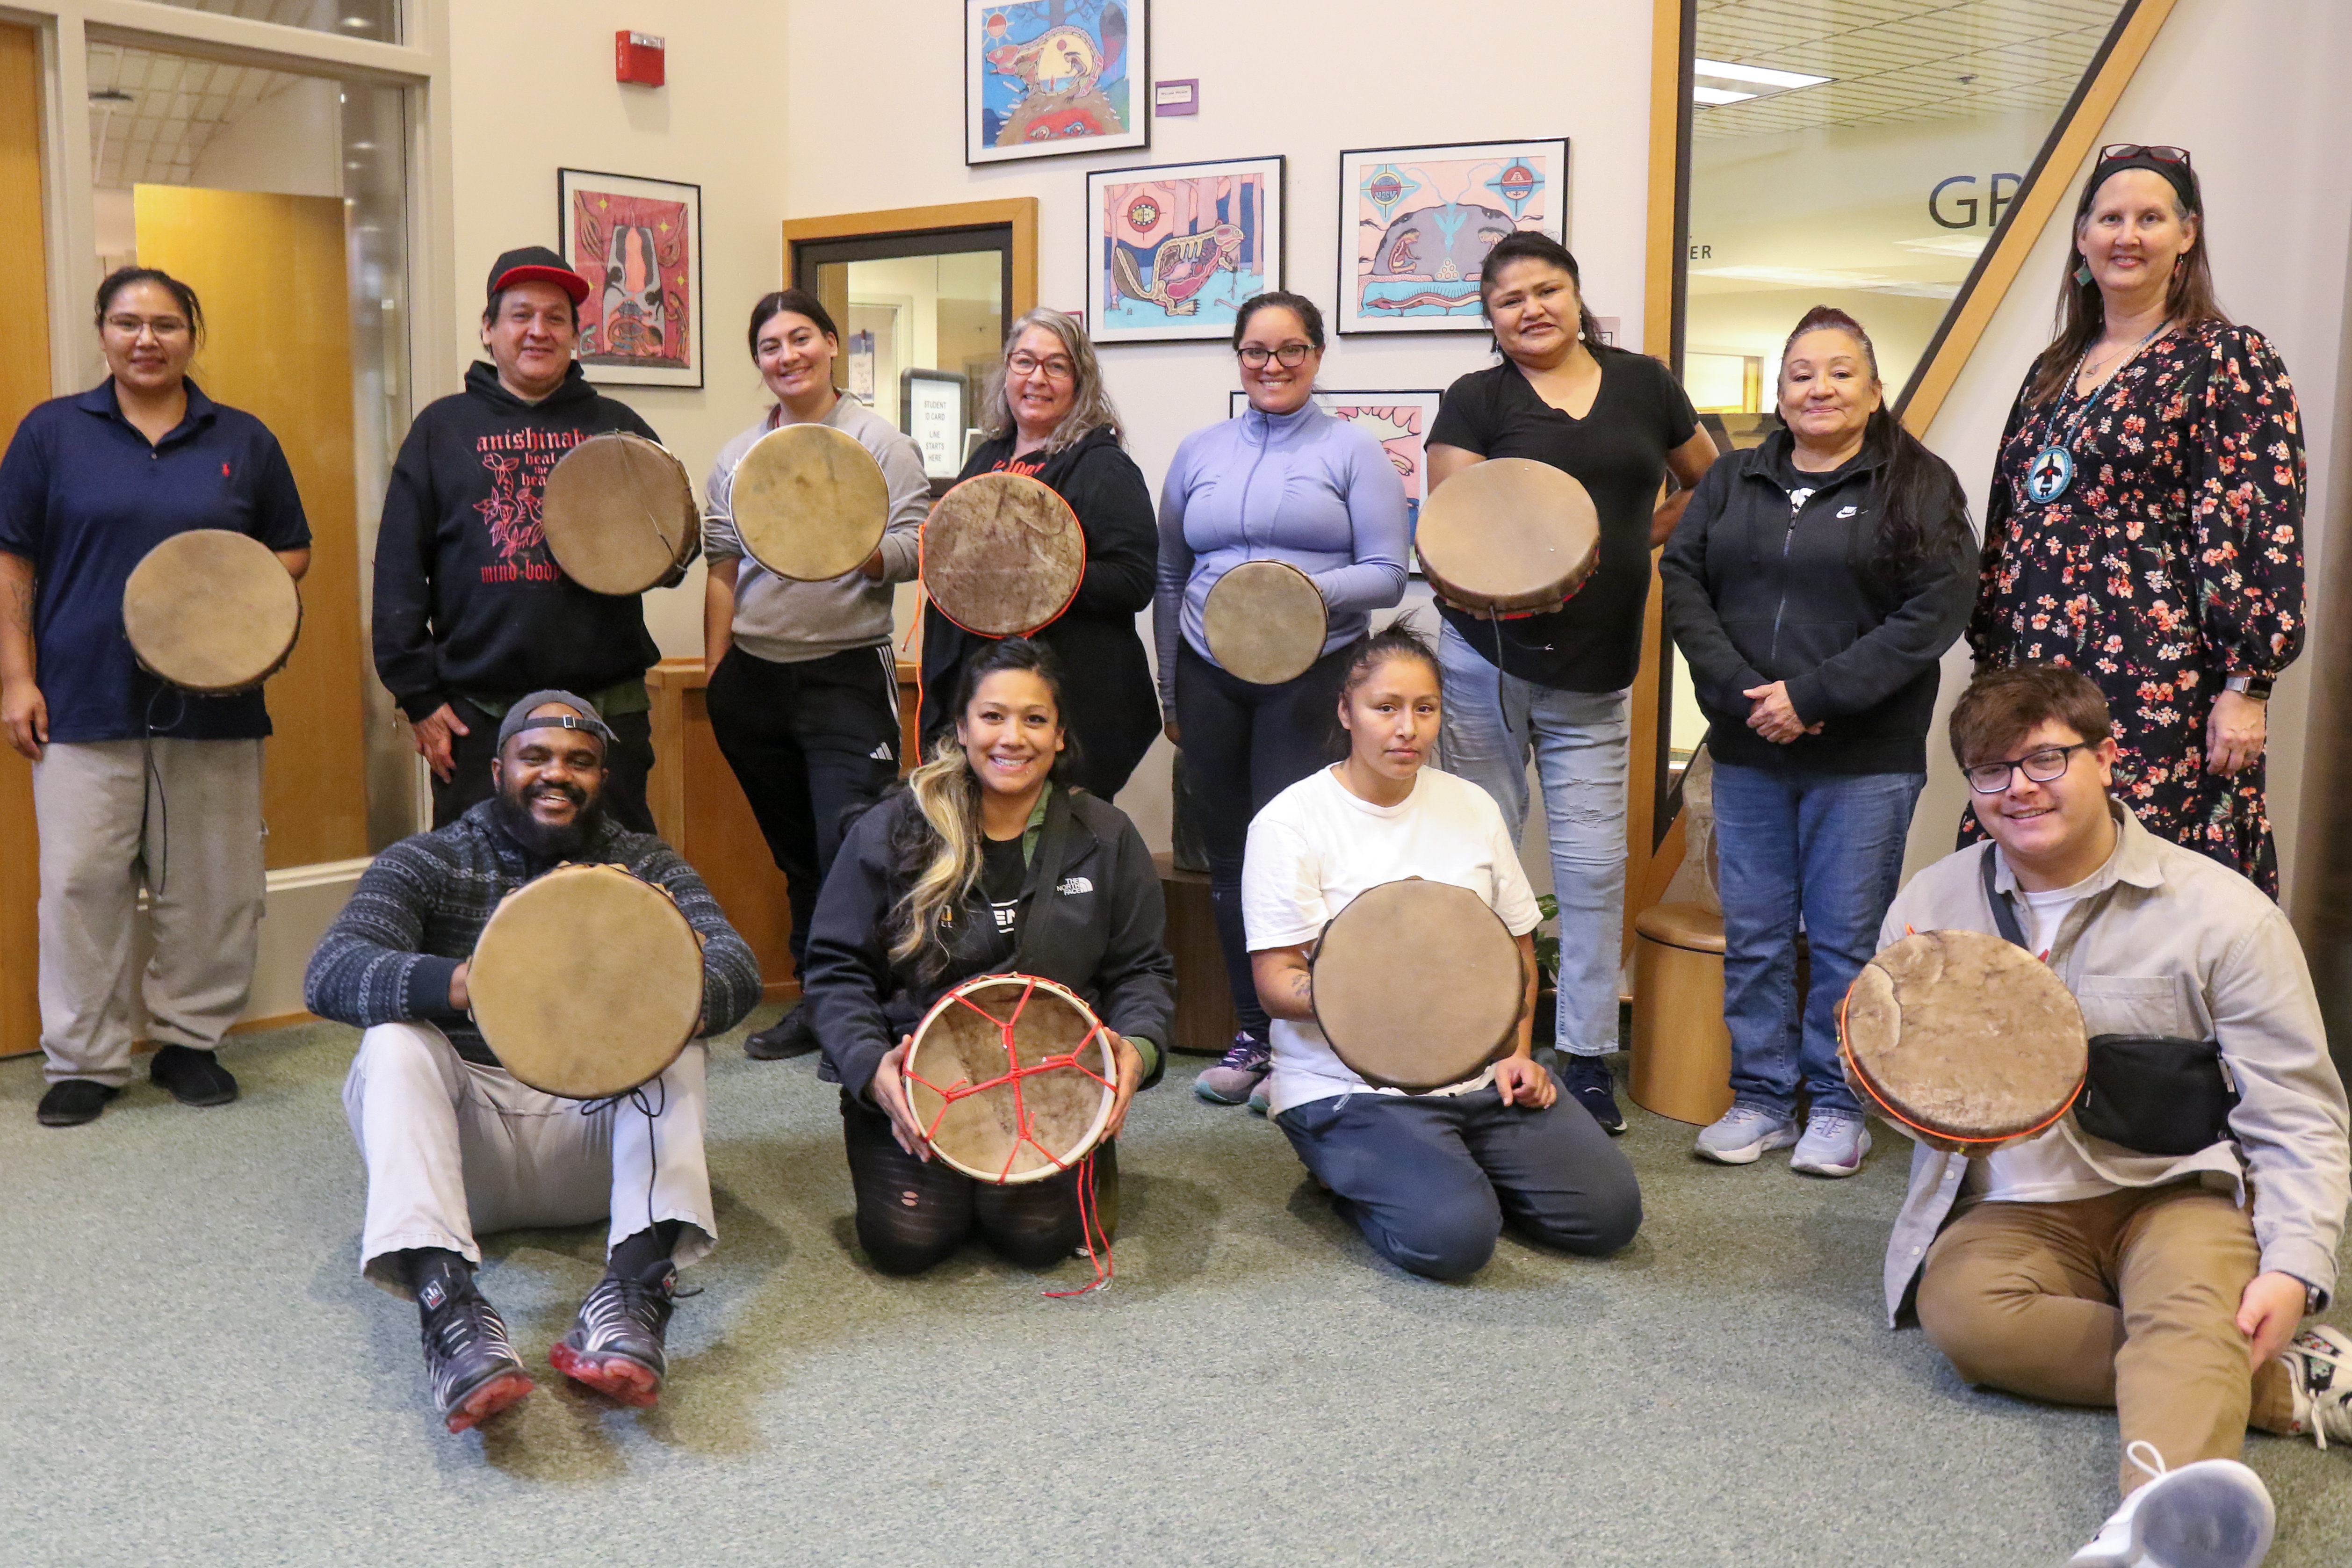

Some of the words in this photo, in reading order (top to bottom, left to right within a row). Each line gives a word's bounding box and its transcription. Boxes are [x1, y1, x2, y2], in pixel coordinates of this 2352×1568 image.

[924, 400, 946, 409] STUDENT
[525, 451, 556, 465] heal
[534, 465, 548, 474] the
[521, 472, 547, 486] hea
[1056, 882, 1080, 892] NORTH
